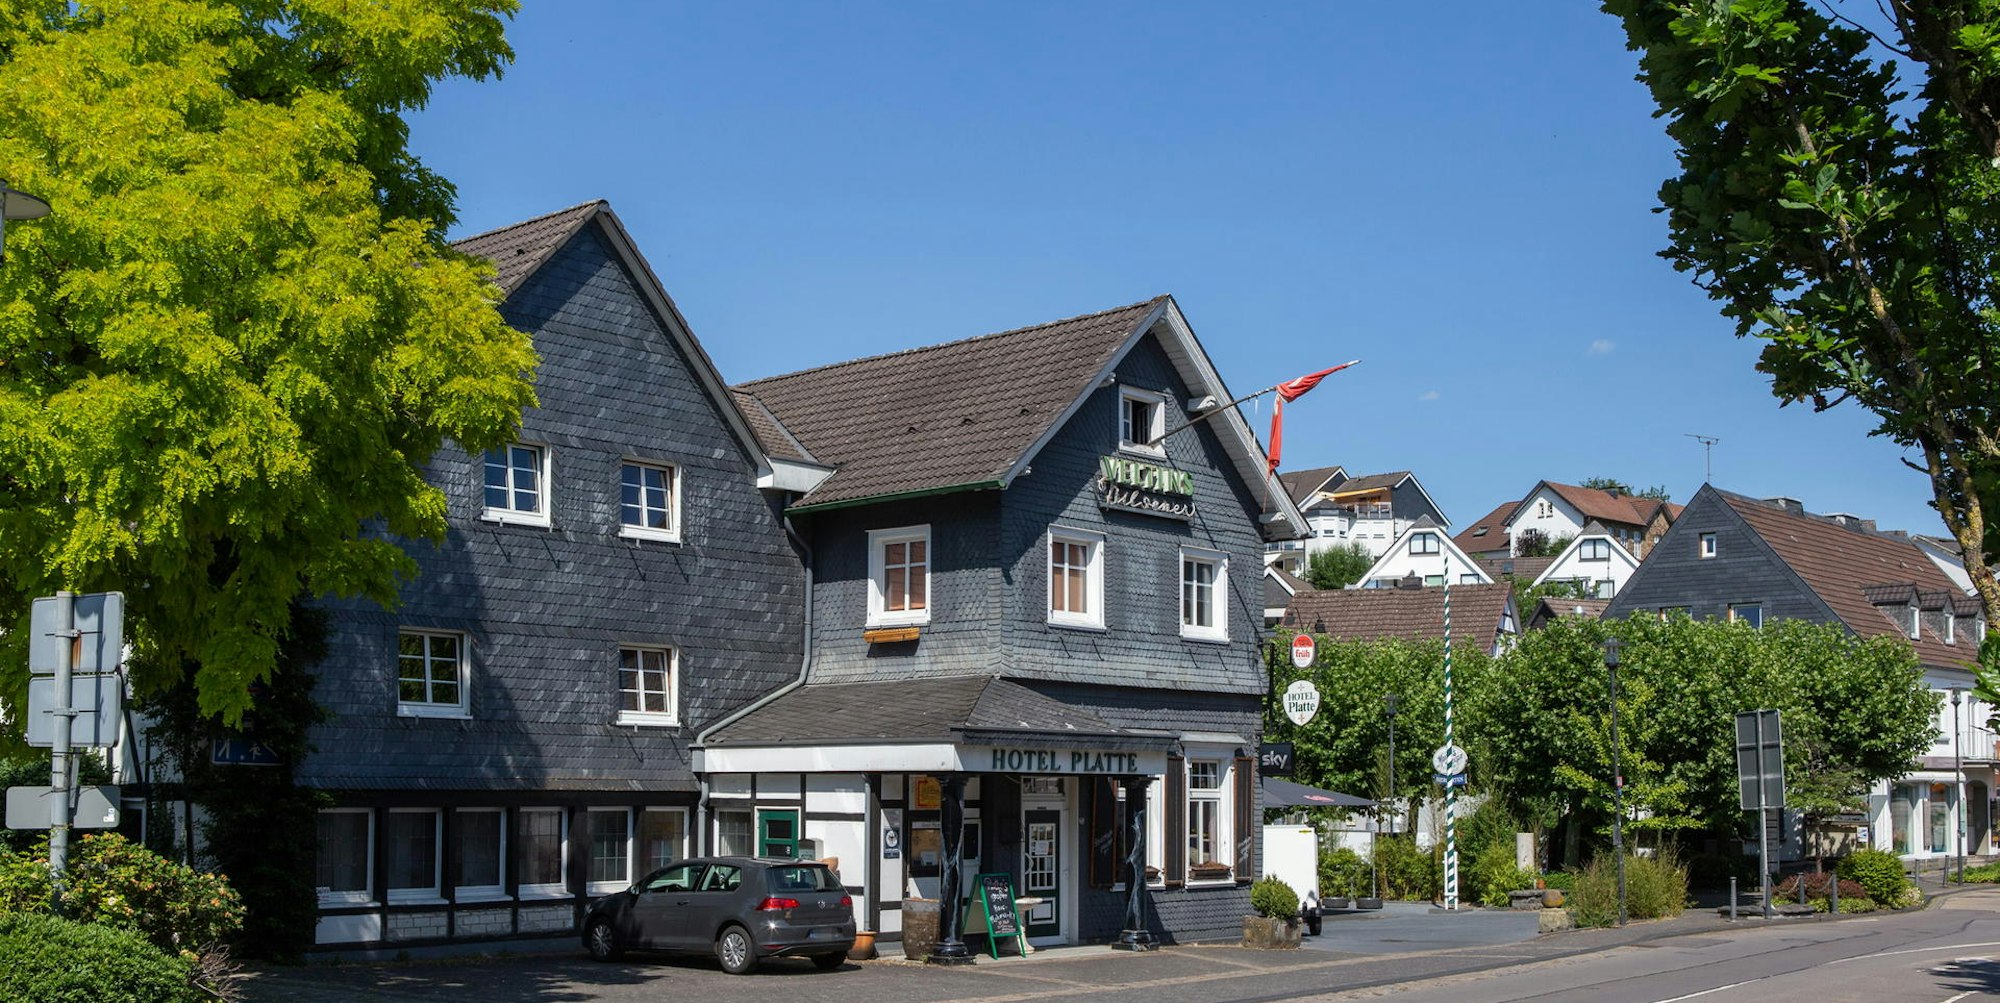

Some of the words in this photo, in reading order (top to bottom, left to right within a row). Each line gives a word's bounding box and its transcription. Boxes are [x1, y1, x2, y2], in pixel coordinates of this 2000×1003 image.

[1288, 692, 1315, 701] HOTEL
[1288, 702, 1316, 712] Platte
[992, 750, 1061, 771] HOTEL
[1071, 751, 1138, 773] PLATTE
[1261, 750, 1288, 770] sky
